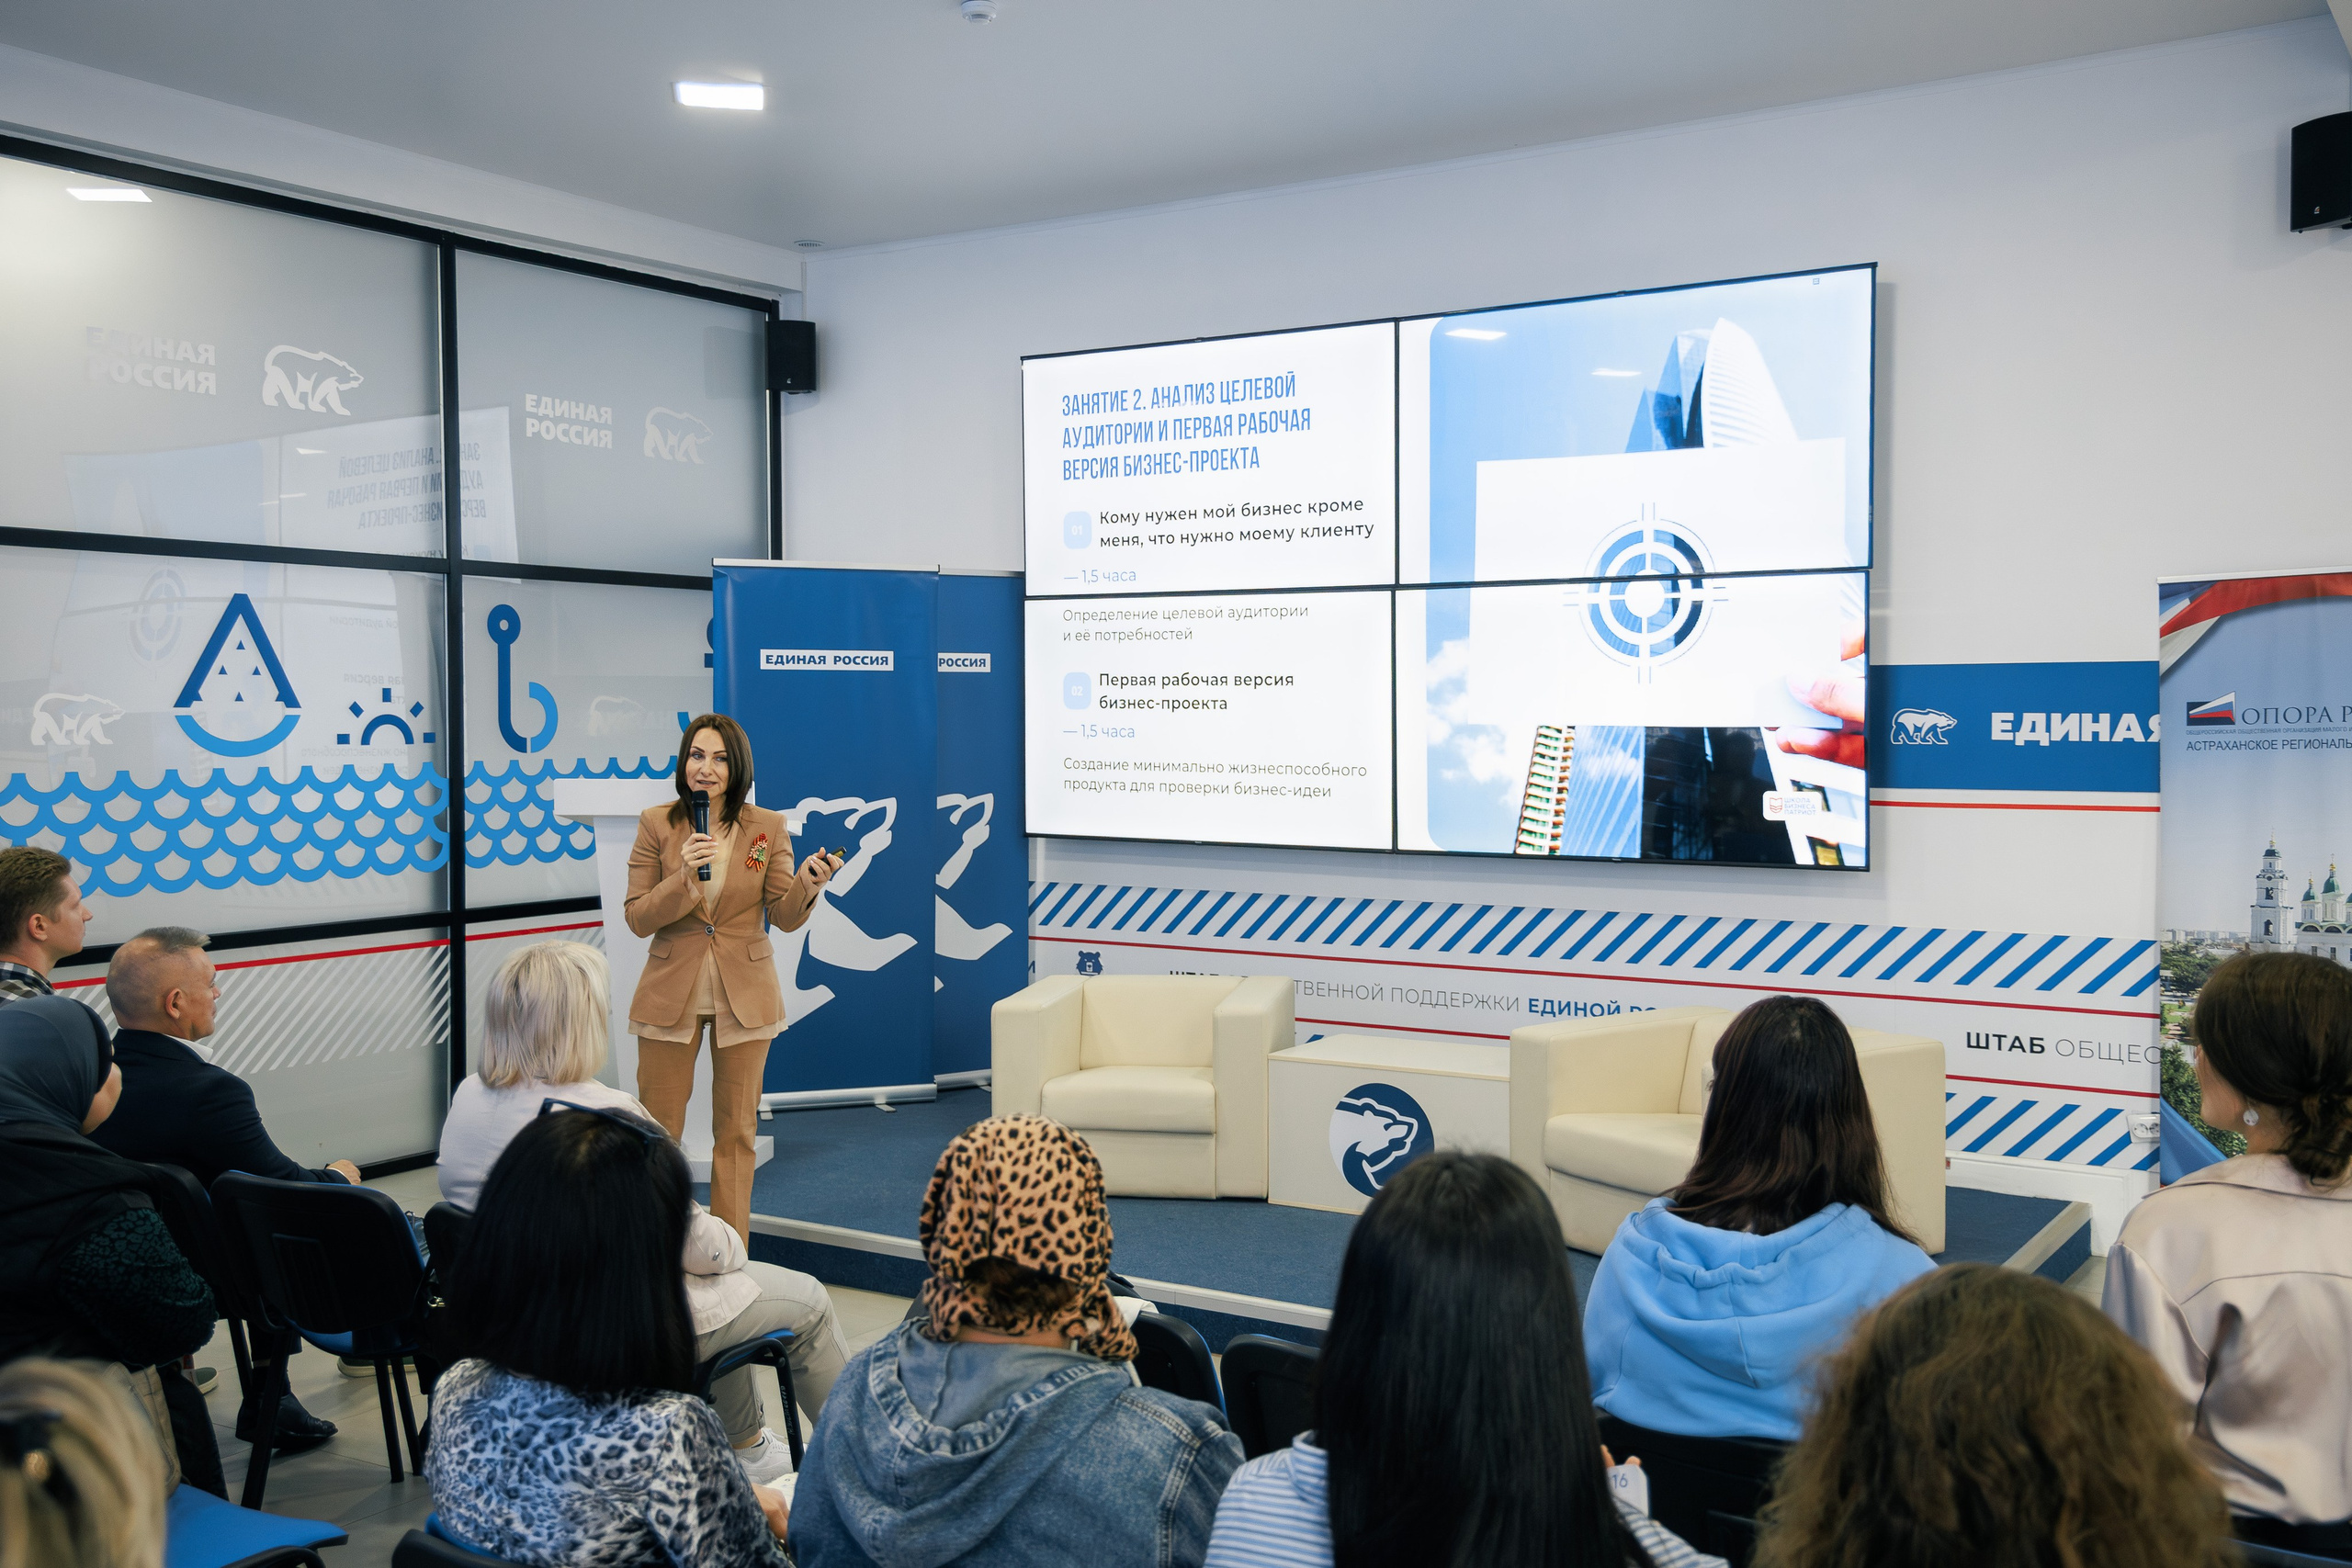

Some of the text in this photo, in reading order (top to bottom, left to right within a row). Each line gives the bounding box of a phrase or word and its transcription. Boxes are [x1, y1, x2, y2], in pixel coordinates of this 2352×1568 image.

[88, 356, 216, 395] РОССИЯ
[1062, 370, 1296, 416] ЗАНЯТИЕ 2. АНАЛИЗ ЦЕЛЕВОЙ
[526, 393, 612, 424] ЕДИНАЯ
[526, 417, 612, 449] РОССИЯ
[1062, 407, 1311, 450] АУДИТОРИИ И ПЕРВАЯ РАБОЧАЯ
[1063, 446, 1261, 481] ВЕРСИЯ БИЗНЕС-ПРОЕКТА
[1100, 500, 1363, 526] Кому нужен мой бизнес кроме
[1071, 525, 1083, 536] 01
[1100, 524, 1374, 548] меня, что нужно моему клиенту
[1081, 570, 1099, 585] 1,5
[1102, 570, 1136, 583] часа
[1062, 604, 1308, 623] Определение целевой аудитории
[1063, 627, 1193, 644] и её потребностей
[765, 654, 889, 666] ЕДИНАЯ РОССИЯ
[938, 658, 987, 668] РОССИЯ
[1099, 671, 1294, 690] Первая рабочая версия
[1071, 685, 1083, 697] 02
[1099, 695, 1228, 713] бизнес-проекта
[2242, 705, 2338, 725] ОПОРА
[1080, 724, 1098, 739] 1,5
[1102, 726, 1136, 739] часа
[2237, 727, 2282, 735] ОБЩЕСТВЕННАЯ
[2186, 738, 2352, 751] АСТРАХАНСКОЕ РЕГИОНАЛЬ
[1063, 757, 1368, 778] Создание минимально жизнеспособного
[1063, 778, 1331, 798] продукта для проверки бизнес-идеи
[1391, 987, 1520, 1012] ПОДДЕРЖКИ
[1528, 998, 1621, 1018] ЕДИНОЙ
[1966, 1031, 2162, 1066] ШТАБ ОБЩЕС
